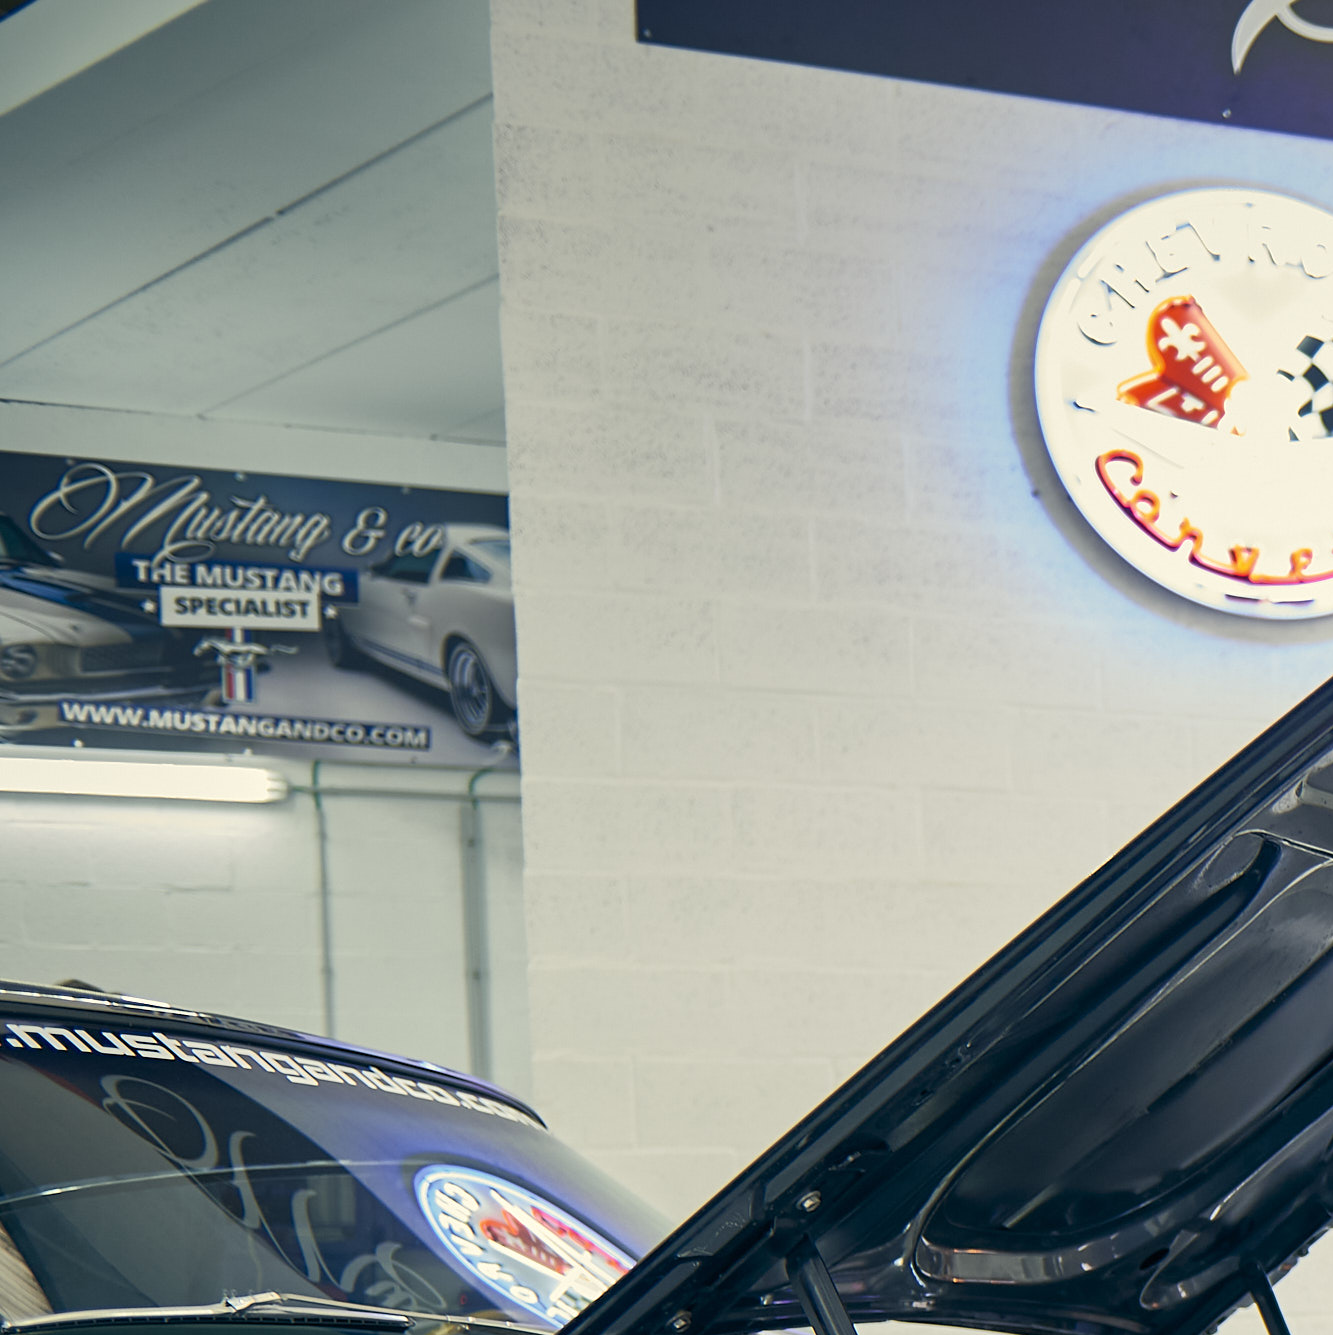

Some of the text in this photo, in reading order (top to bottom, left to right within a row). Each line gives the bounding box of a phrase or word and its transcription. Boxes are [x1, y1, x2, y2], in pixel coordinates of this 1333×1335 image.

[29, 462, 448, 569] Mustang & co
[131, 559, 345, 597] THE MUSTANG
[173, 596, 311, 620] SPECIALIST
[61, 702, 430, 750] WWW.MUSTANGANDCO.COM
[0, 1022, 550, 1134] .mustangandco.com
